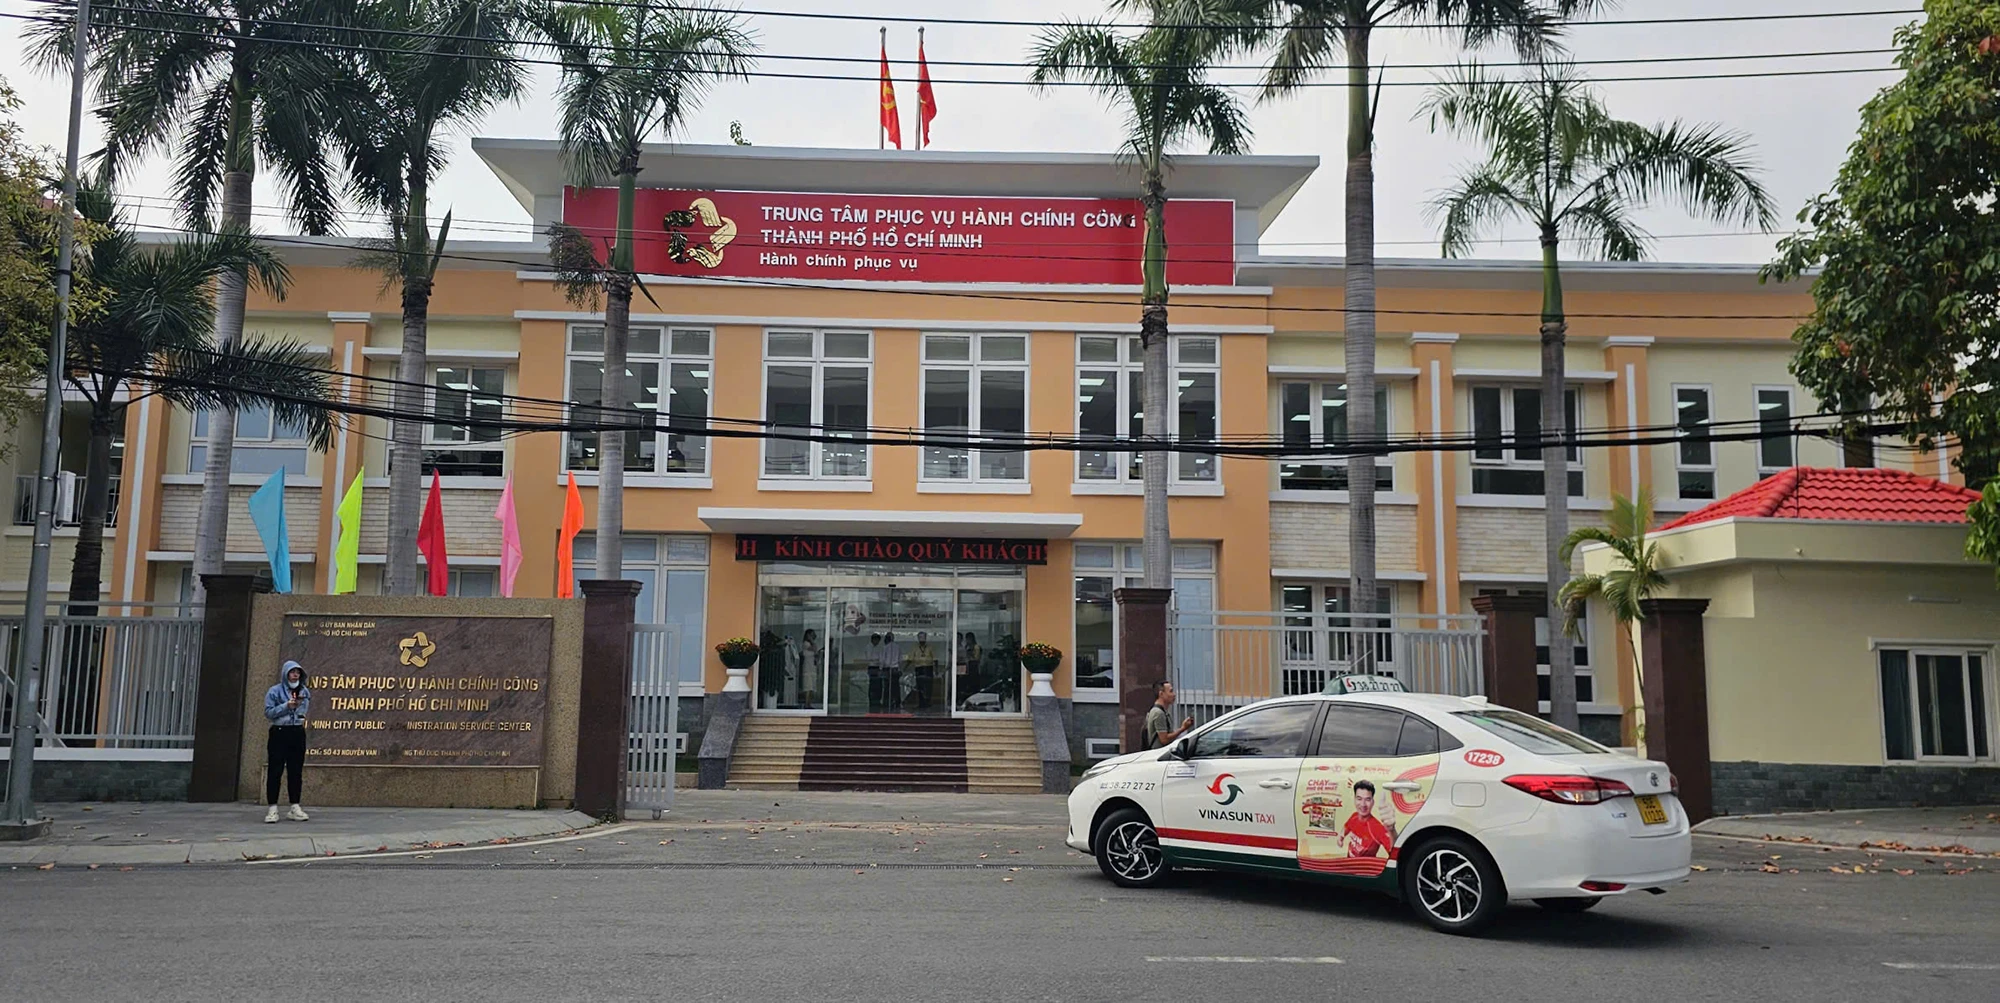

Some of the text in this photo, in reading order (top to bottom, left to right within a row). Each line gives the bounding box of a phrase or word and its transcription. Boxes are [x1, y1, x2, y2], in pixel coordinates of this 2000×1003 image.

[761, 206, 823, 222] TRUNG
[830, 204, 868, 223] TÂM
[875, 208, 924, 228] PHỤC
[931, 210, 955, 228] VỤ
[961, 207, 1013, 226] HÀNH
[1020, 208, 1075, 227] CHÍNH
[760, 226, 983, 248] THÀNH PHỐ HỒ CHÍ MINH
[759, 252, 918, 272] Hành chính phục vụ
[775, 536, 831, 558] KÍNH
[837, 537, 903, 559] CHÀO
[908, 538, 954, 562] QUÝ
[331, 674, 356, 689] TÂM
[359, 676, 396, 692] PHỤC
[399, 677, 416, 692] VỤ
[419, 675, 455, 690] HÀNH
[458, 675, 499, 691] CHÍNH
[502, 676, 539, 691] CÔNG
[377, 693, 406, 711] PHỐ
[408, 694, 427, 711] HỒ
[430, 697, 453, 711] CHÍ
[456, 698, 489, 711] MINH
[333, 720, 352, 730] CITY
[354, 720, 386, 730] PUBLIC
[459, 721, 495, 731] SERVICE
[498, 722, 532, 731] CENTER
[332, 748, 341, 756] 43
[1468, 752, 1501, 765] 17238
[1199, 809, 1275, 824] VINASUN TAXI
